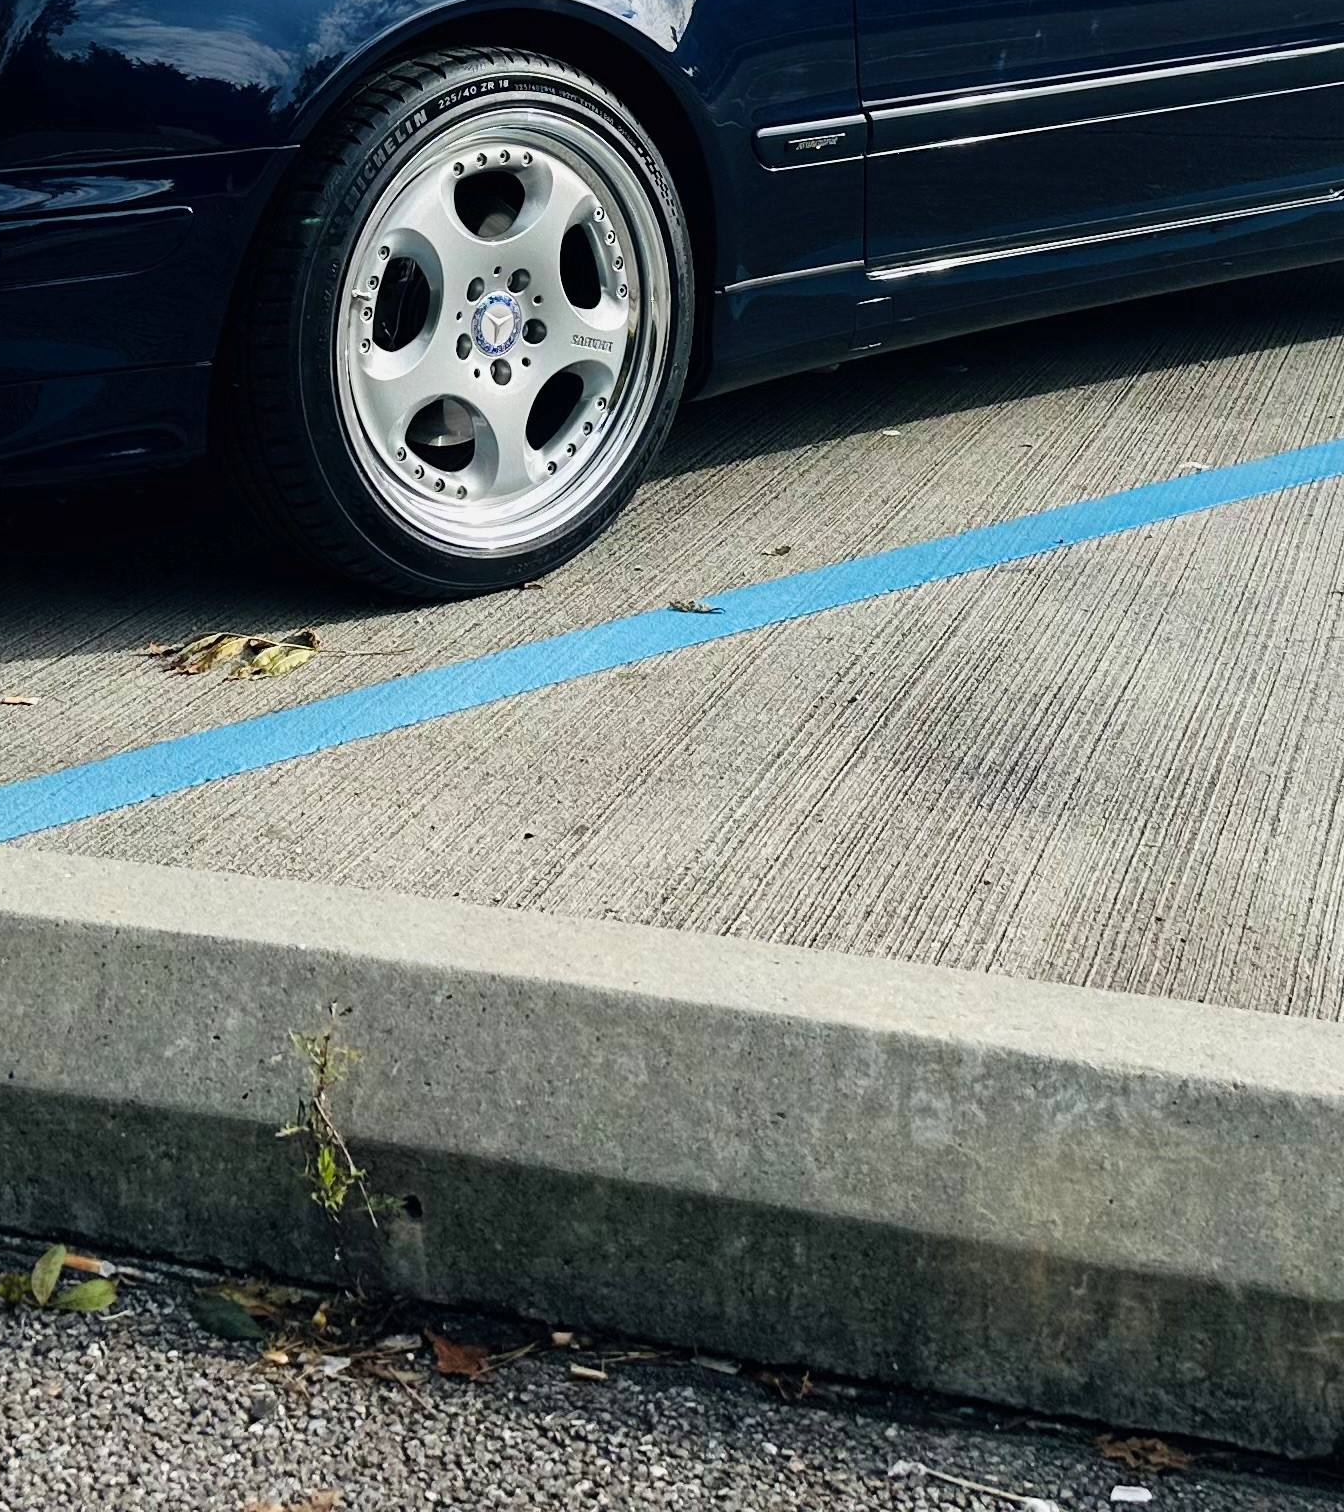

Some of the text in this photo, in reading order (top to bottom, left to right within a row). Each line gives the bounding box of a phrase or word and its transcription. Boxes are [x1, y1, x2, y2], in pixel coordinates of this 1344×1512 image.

[344, 79, 509, 211] MICHELIN 225/40 ZR 18
